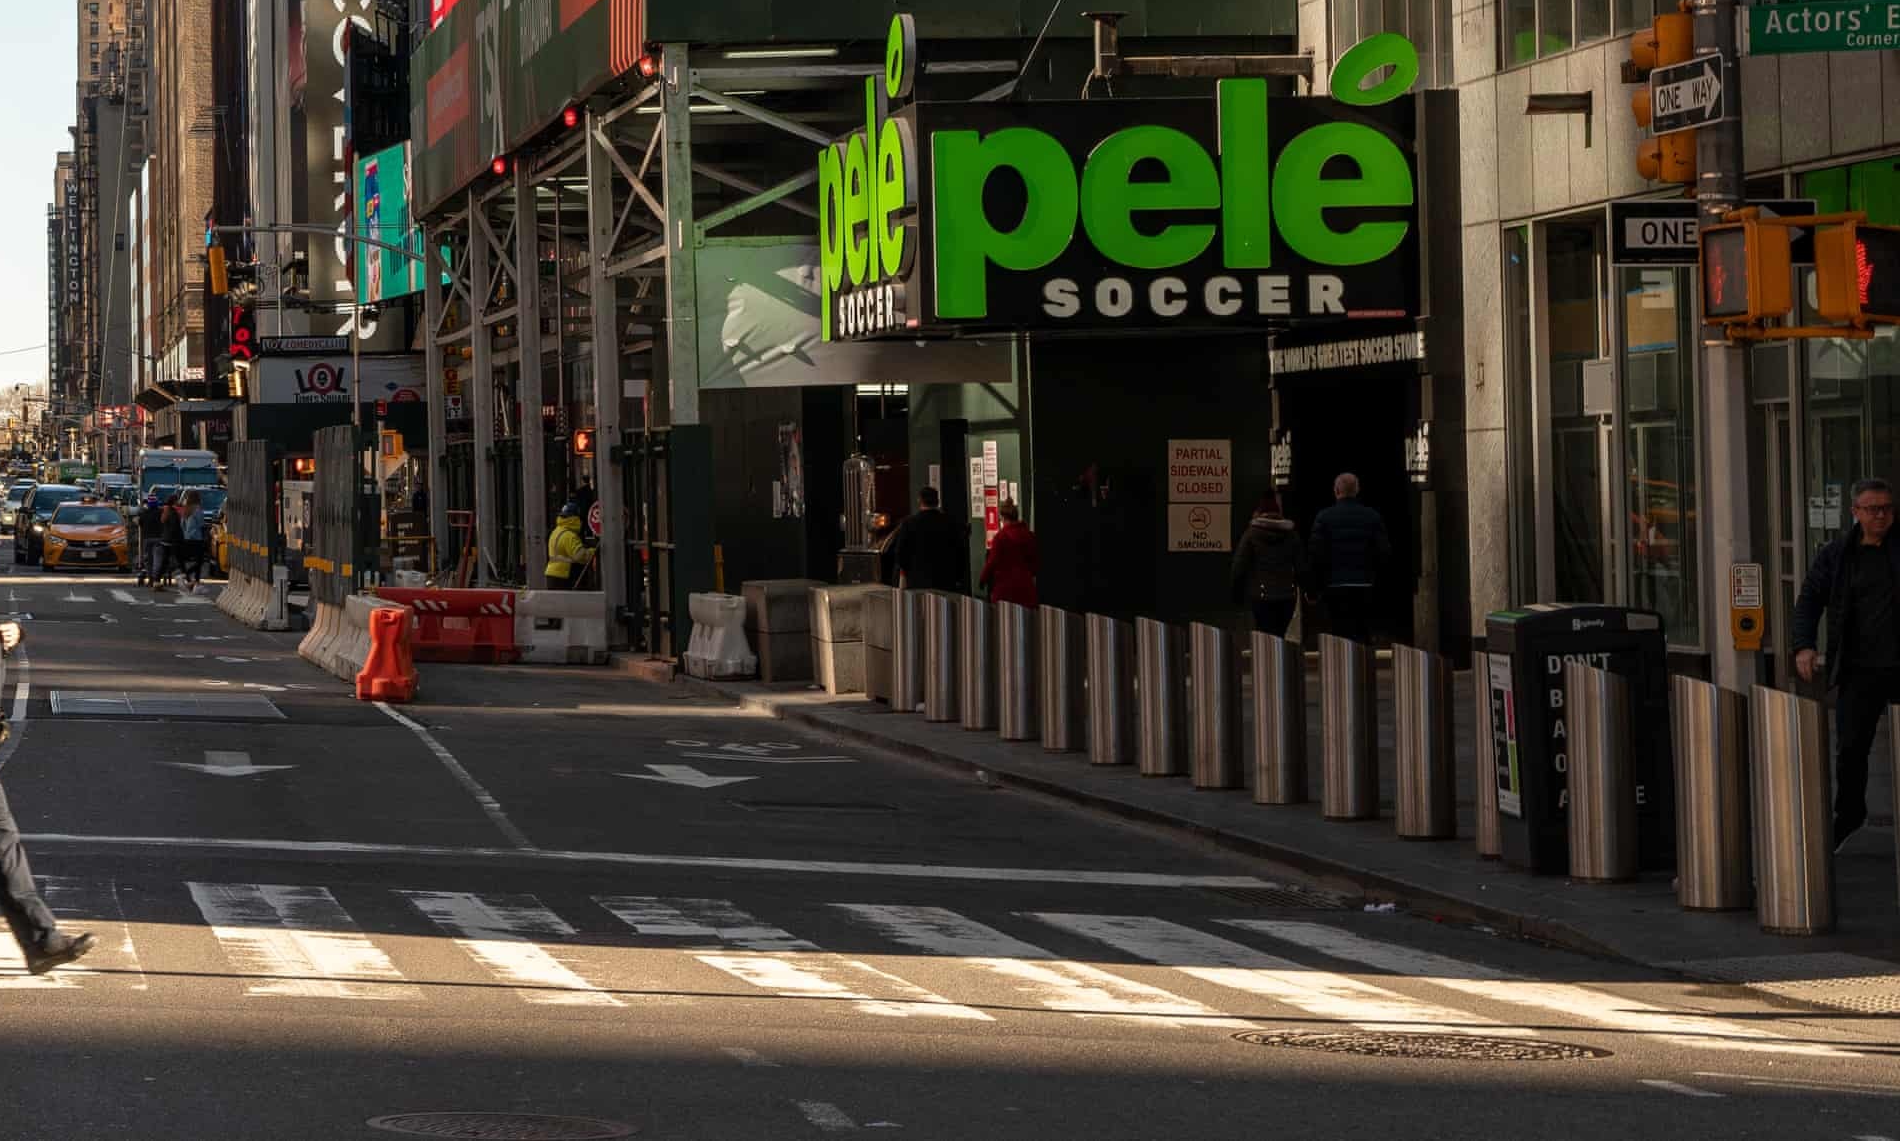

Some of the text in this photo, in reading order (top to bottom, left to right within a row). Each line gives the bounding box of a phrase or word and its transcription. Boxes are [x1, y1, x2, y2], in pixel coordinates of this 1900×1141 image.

[1765, 4, 1870, 35] Actors'
[1846, 32, 1900, 47] Corner
[1658, 75, 1713, 113] ONE WAY
[931, 32, 1419, 319] pelé
[65, 182, 79, 303] WELLINGTON
[1641, 221, 1698, 245] ONE
[1043, 275, 1347, 318] SOCCER
[838, 289, 897, 336] SOCCER
[1285, 345, 1316, 373] WORLD'S
[1316, 341, 1356, 369] GREATEST
[1356, 336, 1391, 364] SOCCER
[1391, 330, 1421, 359] STORE
[294, 362, 348, 395] LOL
[1175, 448, 1223, 460] PARTIAL
[1170, 465, 1229, 477] SIDEWALK
[1177, 482, 1224, 494] CLOSED
[1178, 540, 1222, 549] SMOKING
[1192, 531, 1207, 540] NO
